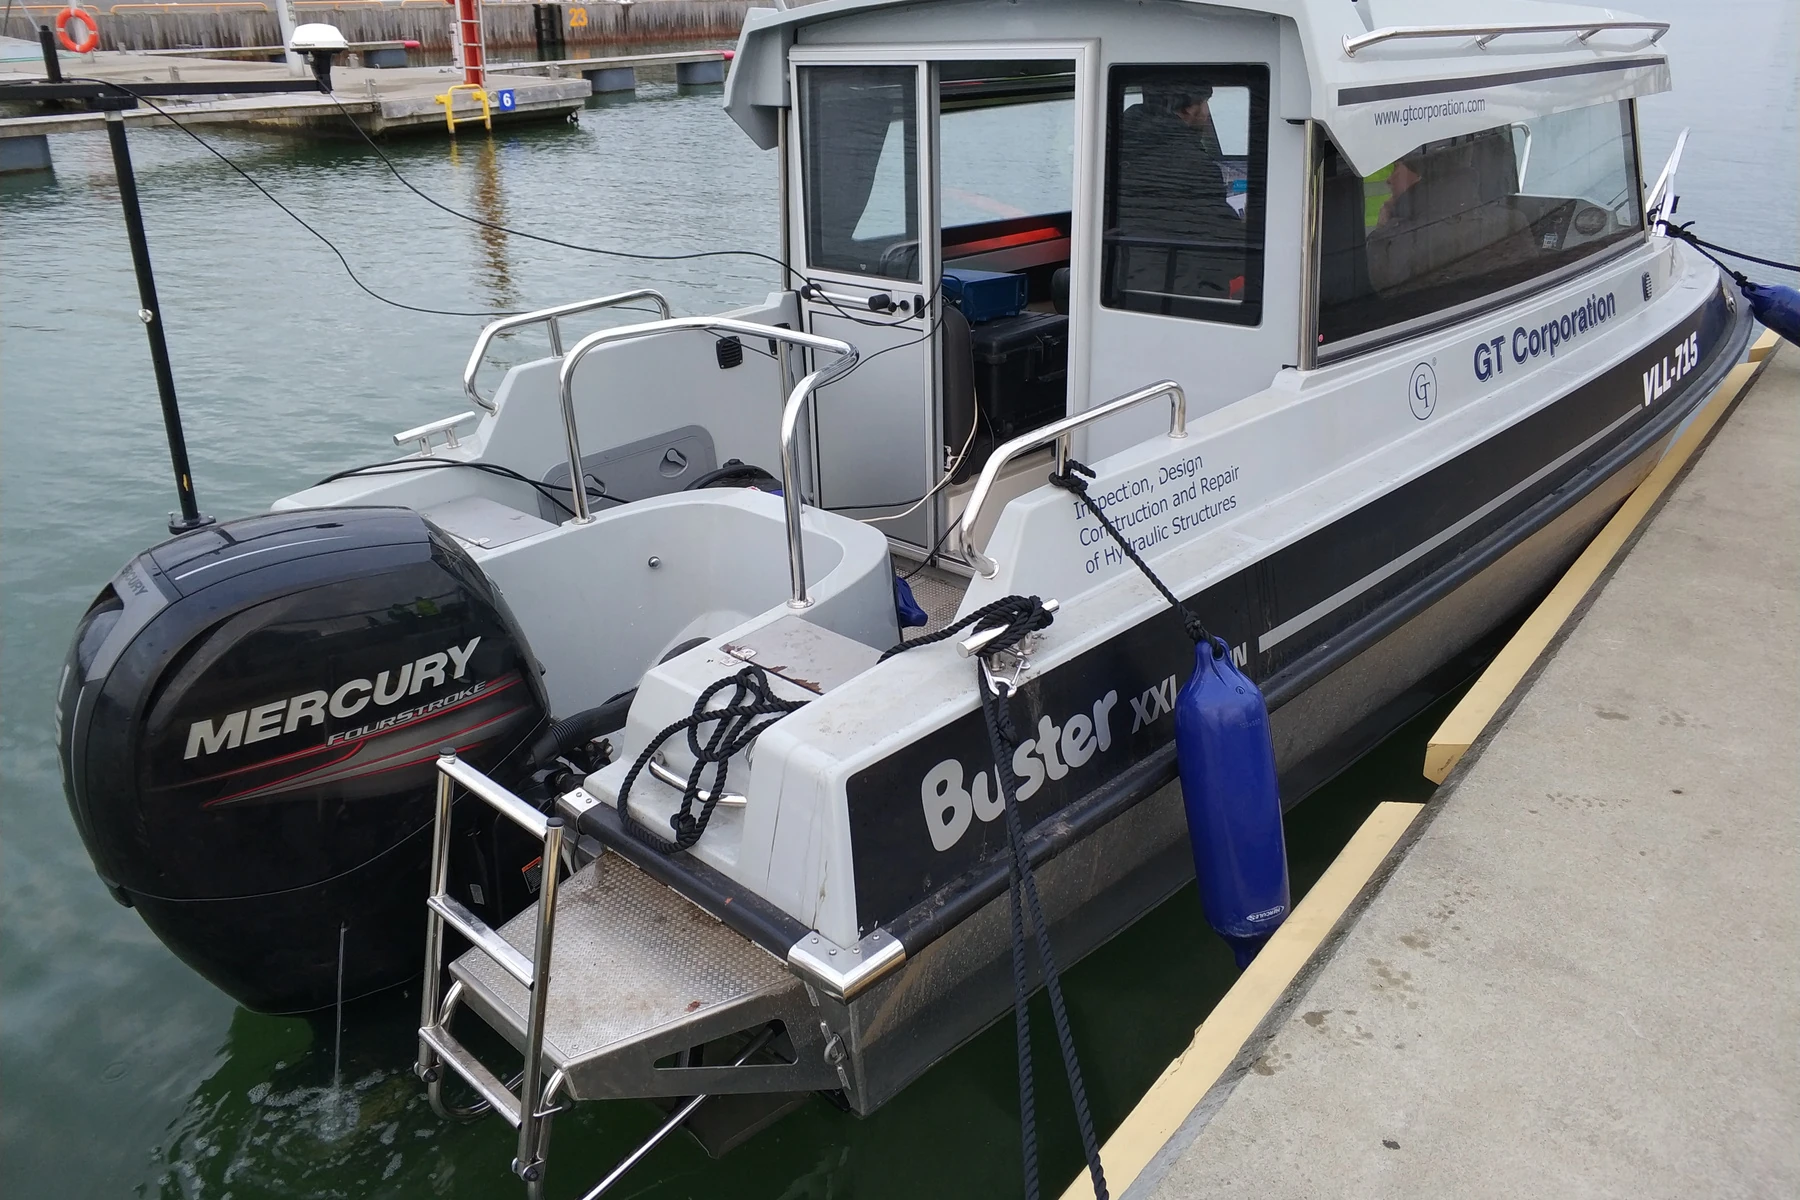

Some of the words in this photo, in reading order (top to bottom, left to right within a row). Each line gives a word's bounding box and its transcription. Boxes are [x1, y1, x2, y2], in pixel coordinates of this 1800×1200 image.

[568, 7, 588, 27] 23
[503, 93, 512, 107] 6
[1374, 98, 1486, 126] www.gtcorporation.com
[1473, 335, 1505, 382] GT
[1512, 291, 1616, 364] Corporation
[1643, 331, 1698, 407] VLL-715
[1079, 498, 1168, 546] Contruction
[1172, 481, 1197, 507] and
[1201, 465, 1240, 495] Repair
[1158, 455, 1203, 485] Design
[1085, 551, 1100, 574] of
[1172, 495, 1237, 535] Structures
[183, 636, 482, 760] MERCURY
[326, 680, 486, 746] FOURSTROKE
[921, 689, 1117, 851] Buster
